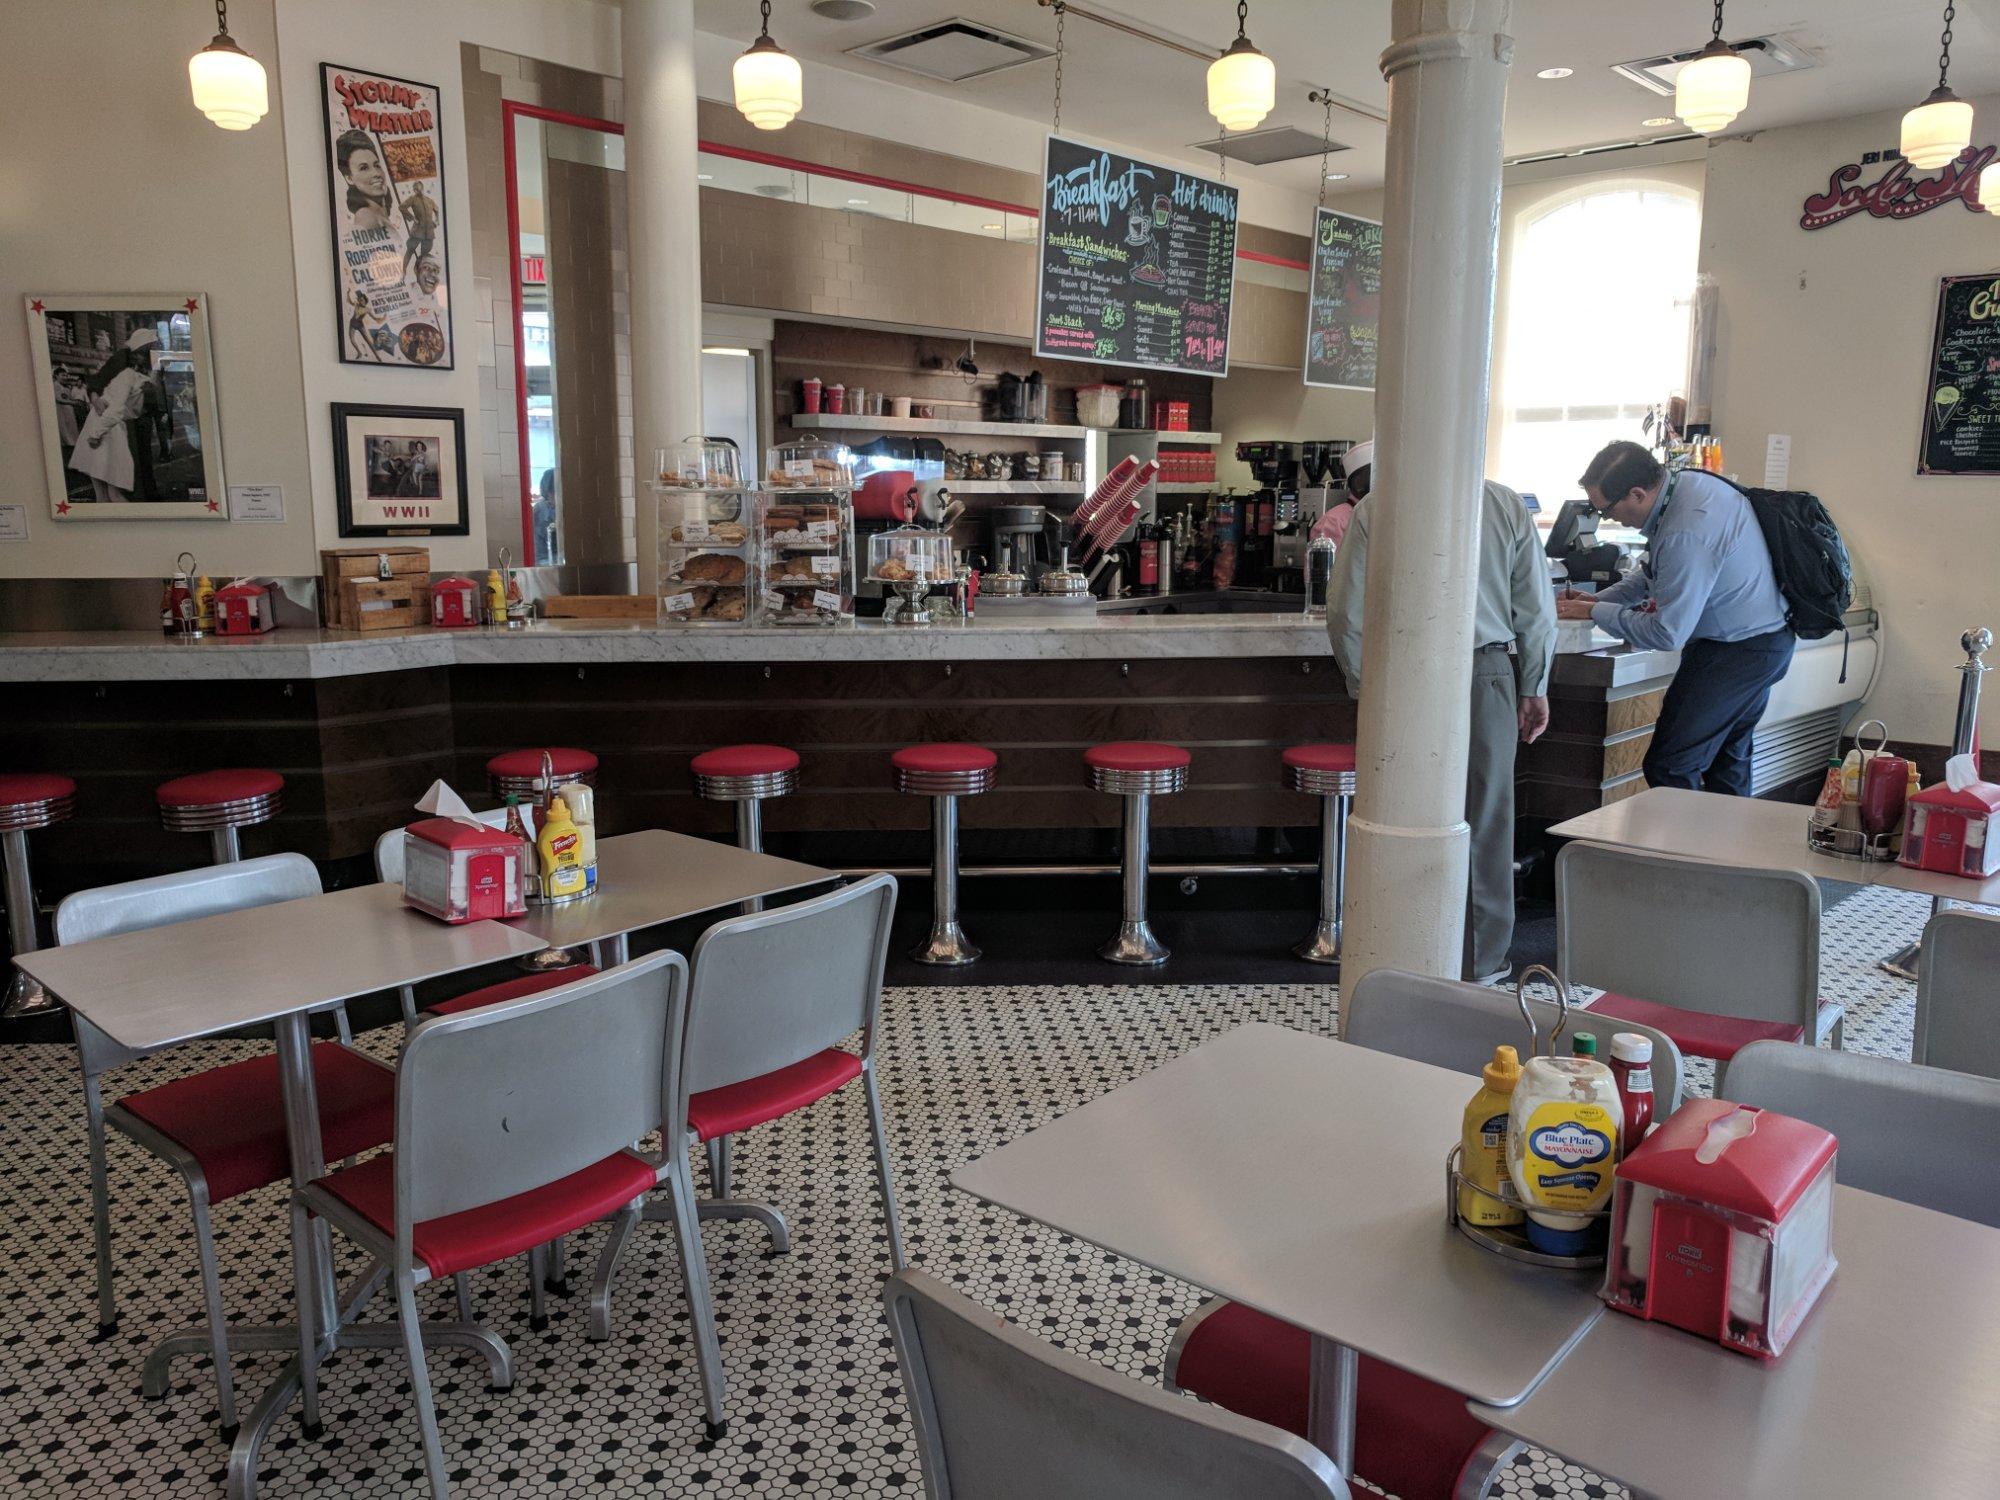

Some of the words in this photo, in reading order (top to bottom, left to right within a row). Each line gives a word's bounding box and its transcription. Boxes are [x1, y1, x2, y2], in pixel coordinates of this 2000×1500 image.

[335, 75, 421, 110] STORMY
[346, 107, 433, 134] WEATHER
[1047, 153, 1155, 227] Breakfast
[1172, 174, 1199, 210] Hot
[1200, 184, 1236, 222] drinks
[352, 226, 390, 246] HORNE
[1048, 231, 1084, 249] Breakfast
[1084, 236, 1128, 262] Sandwiches
[1955, 327, 1991, 337] Chocolate
[1544, 1145, 1595, 1155] MAYONNAISE
[1545, 1134, 1567, 1143] Blue
[1570, 1136, 1595, 1145] Plate
